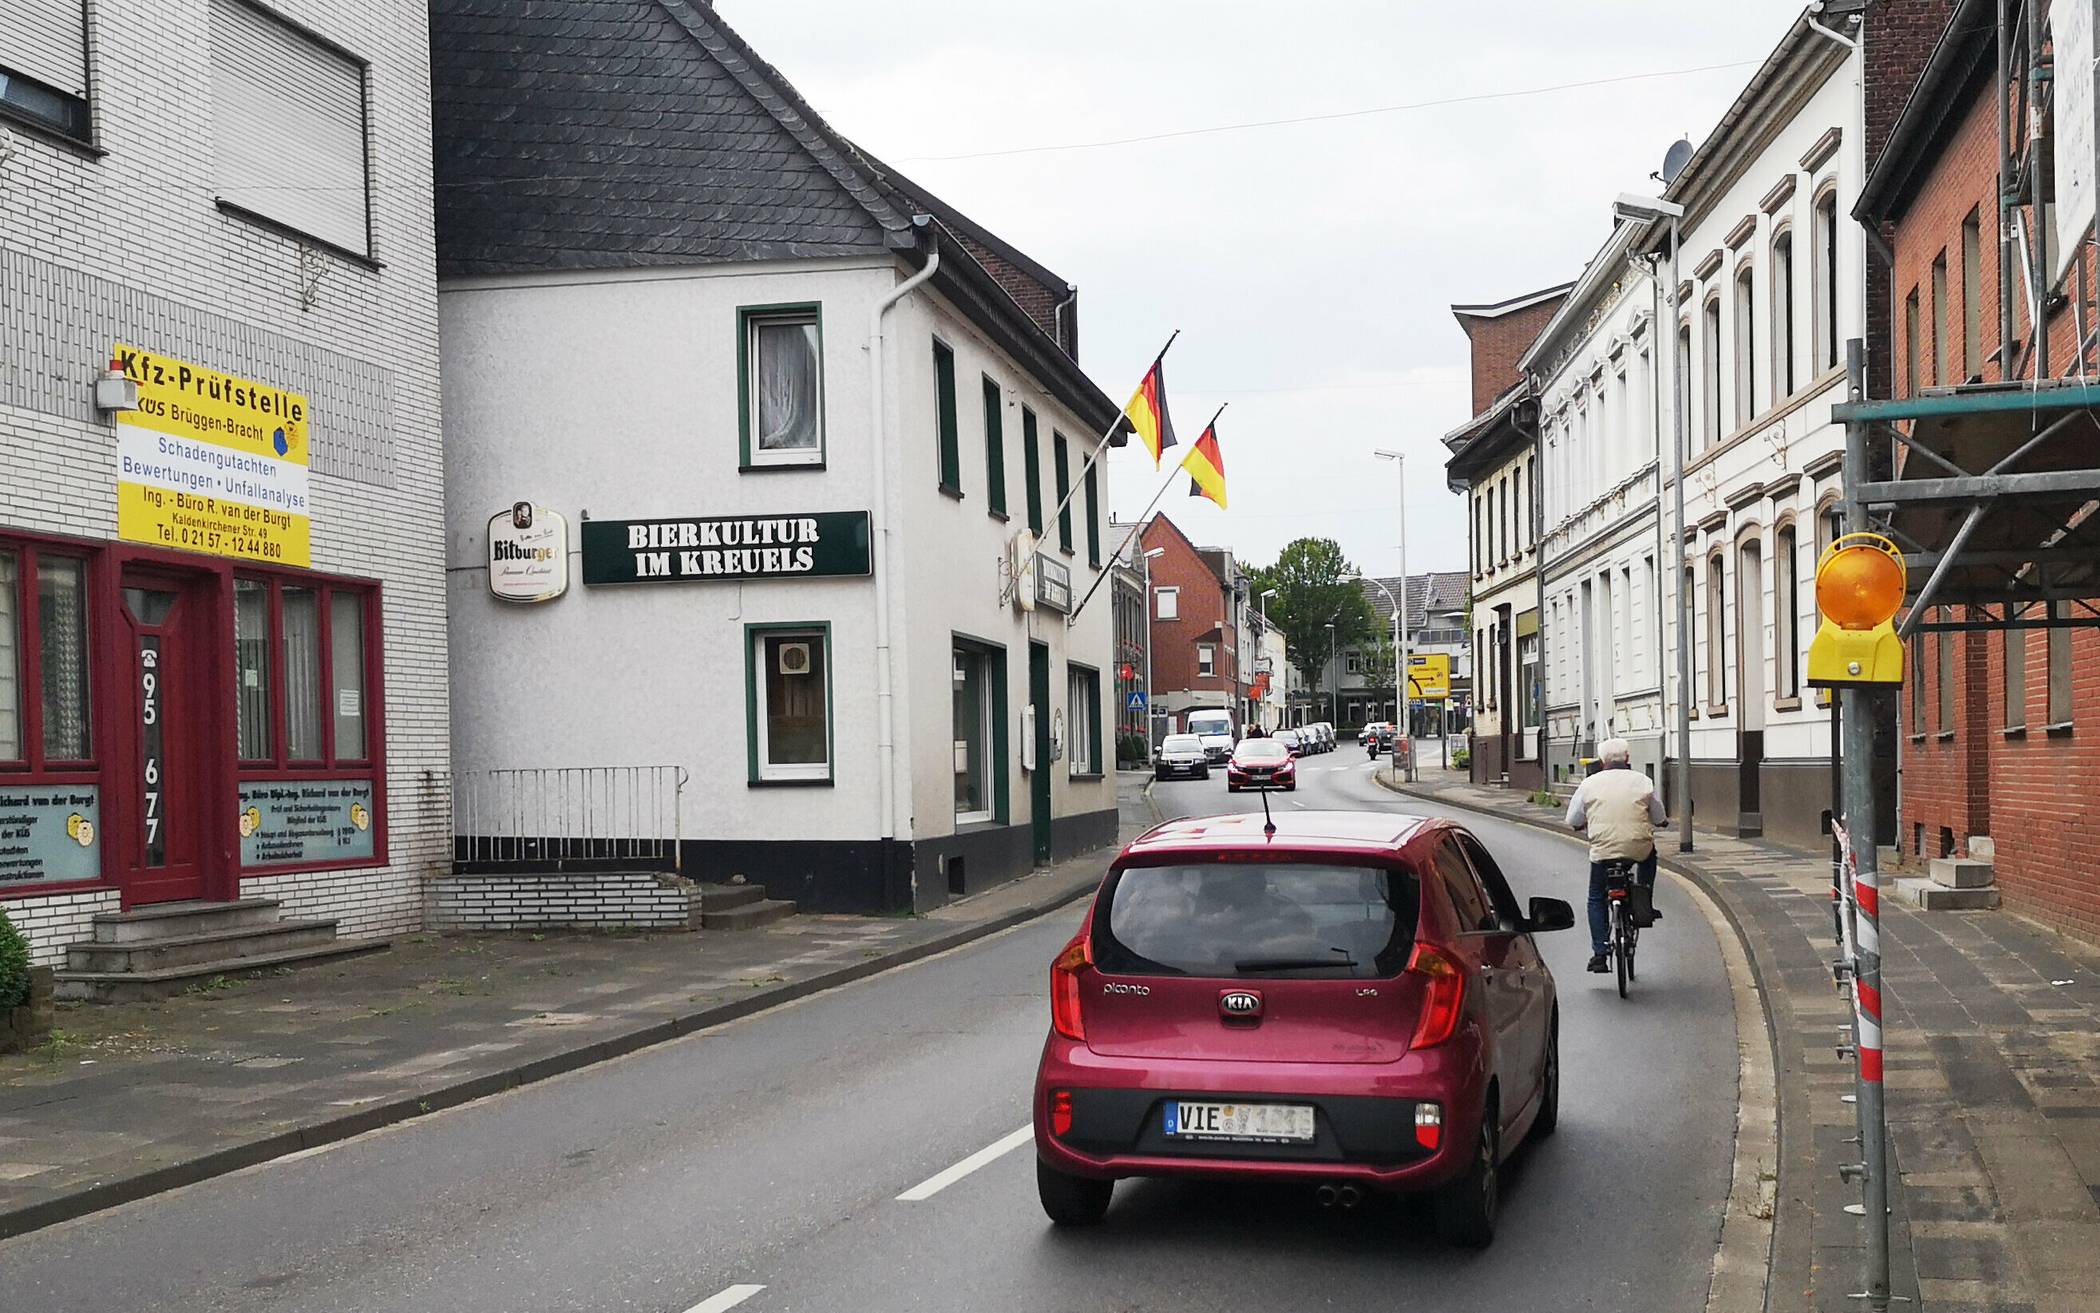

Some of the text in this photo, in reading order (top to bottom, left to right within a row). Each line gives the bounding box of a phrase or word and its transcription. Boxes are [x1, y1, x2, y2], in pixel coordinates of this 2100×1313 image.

[121, 350, 303, 422] Kfz-Prüfstelle
[171, 404, 264, 441] Brüggen-Bracht
[159, 437, 277, 477] Schadengutachten
[123, 457, 305, 508] Bewertungen Unfallanalyse
[144, 487, 166, 508] Ing.
[177, 493, 204, 511] Büro
[208, 499, 218, 515] R.
[222, 504, 240, 519] van
[244, 506, 260, 521] der
[263, 509, 291, 530] Burgt
[157, 524, 178, 542] Tel.
[182, 528, 188, 543] 0
[192, 530, 204, 546] 21
[208, 533, 220, 548] 57
[232, 537, 244, 552] 12
[247, 540, 259, 555] 44
[263, 541, 281, 558] 880
[173, 512, 267, 539] Kaldenkirchener Str. 49
[628, 518, 820, 549] BIERKULTUR
[494, 540, 557, 562] Bitburger
[635, 547, 814, 577] IM KREUELS
[33, 797, 50, 806] van
[52, 794, 67, 806] der
[1228, 996, 1253, 1009] KIA
[1180, 1105, 1220, 1132] VIE
